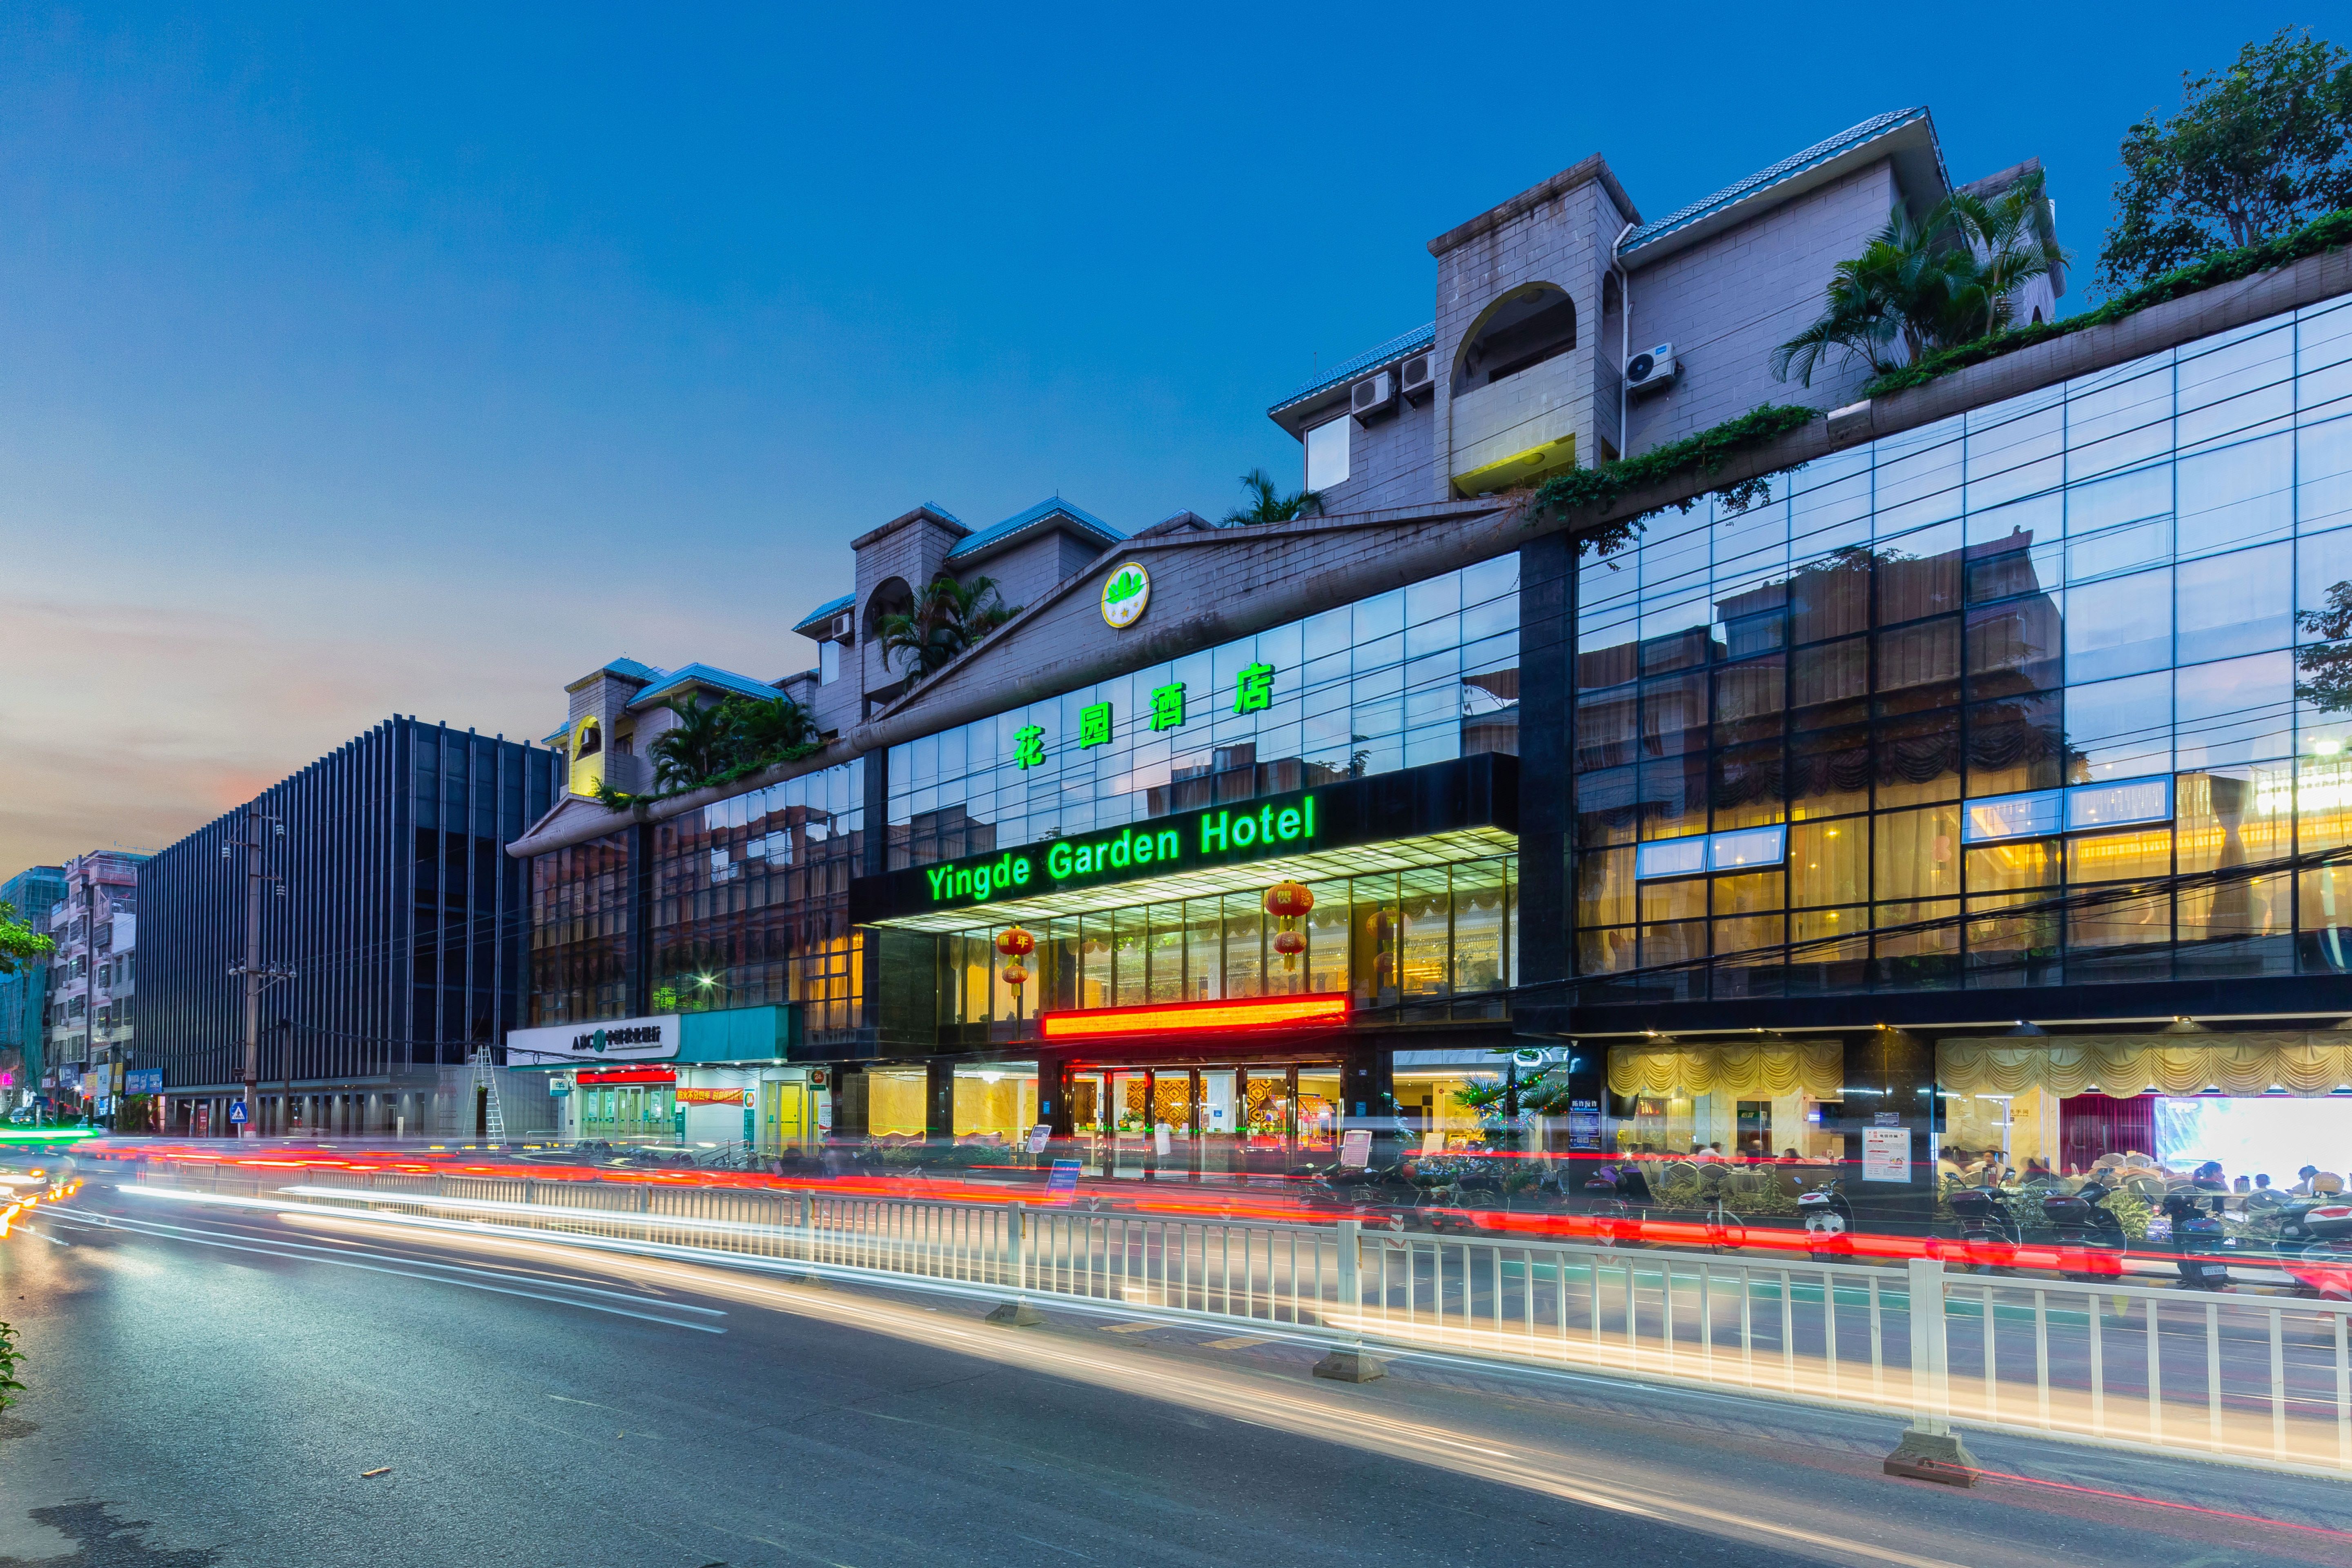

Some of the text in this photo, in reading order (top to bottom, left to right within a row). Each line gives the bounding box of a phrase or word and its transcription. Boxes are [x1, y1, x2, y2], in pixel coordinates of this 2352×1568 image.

[1013, 662, 1274, 770] 花园酒店
[927, 795, 1313, 900] Yingde Garden Hotel
[572, 1034, 595, 1050] ABC
[606, 1026, 661, 1046] 中国农业银行
[677, 1090, 710, 1100] 防火不分四季
